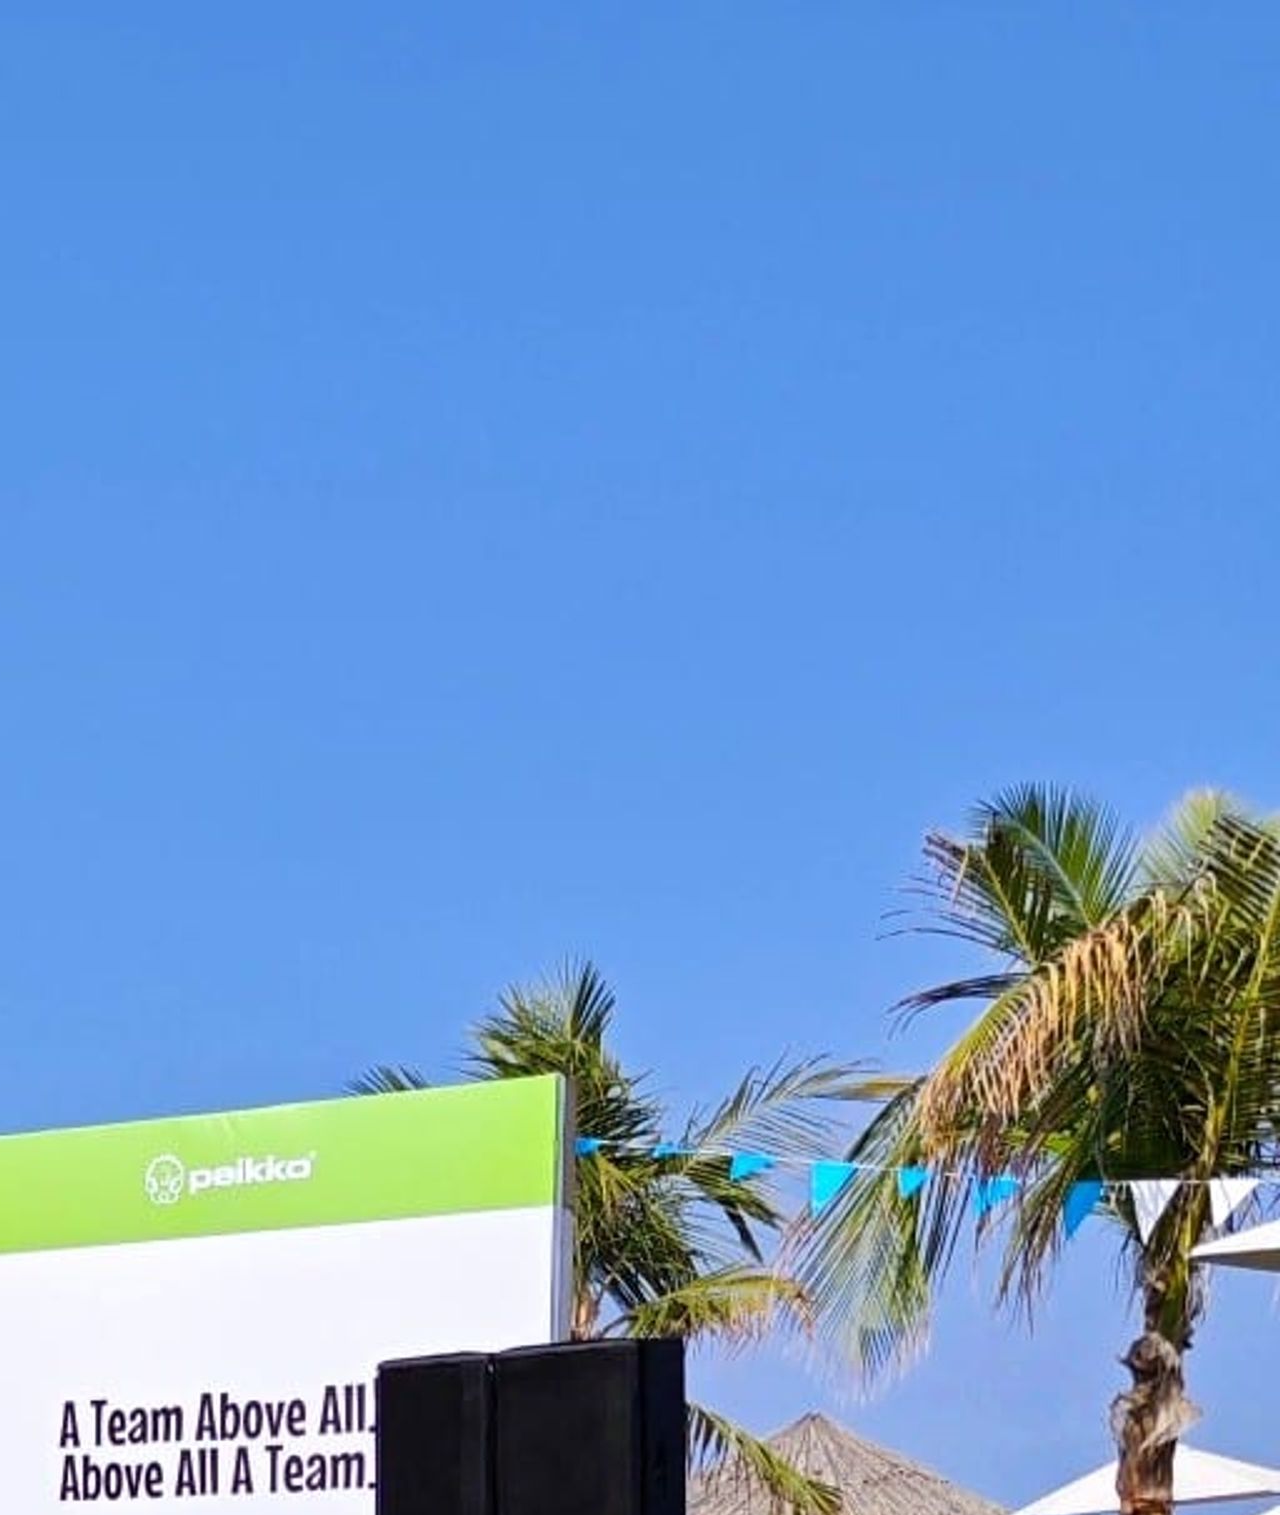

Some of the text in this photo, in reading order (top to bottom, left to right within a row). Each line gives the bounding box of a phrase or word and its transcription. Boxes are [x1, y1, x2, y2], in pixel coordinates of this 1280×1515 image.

[60, 1400, 81, 1448] A
[90, 1399, 184, 1447] Team
[195, 1392, 307, 1441] Above
[59, 1444, 376, 1501] Above All A Team.
